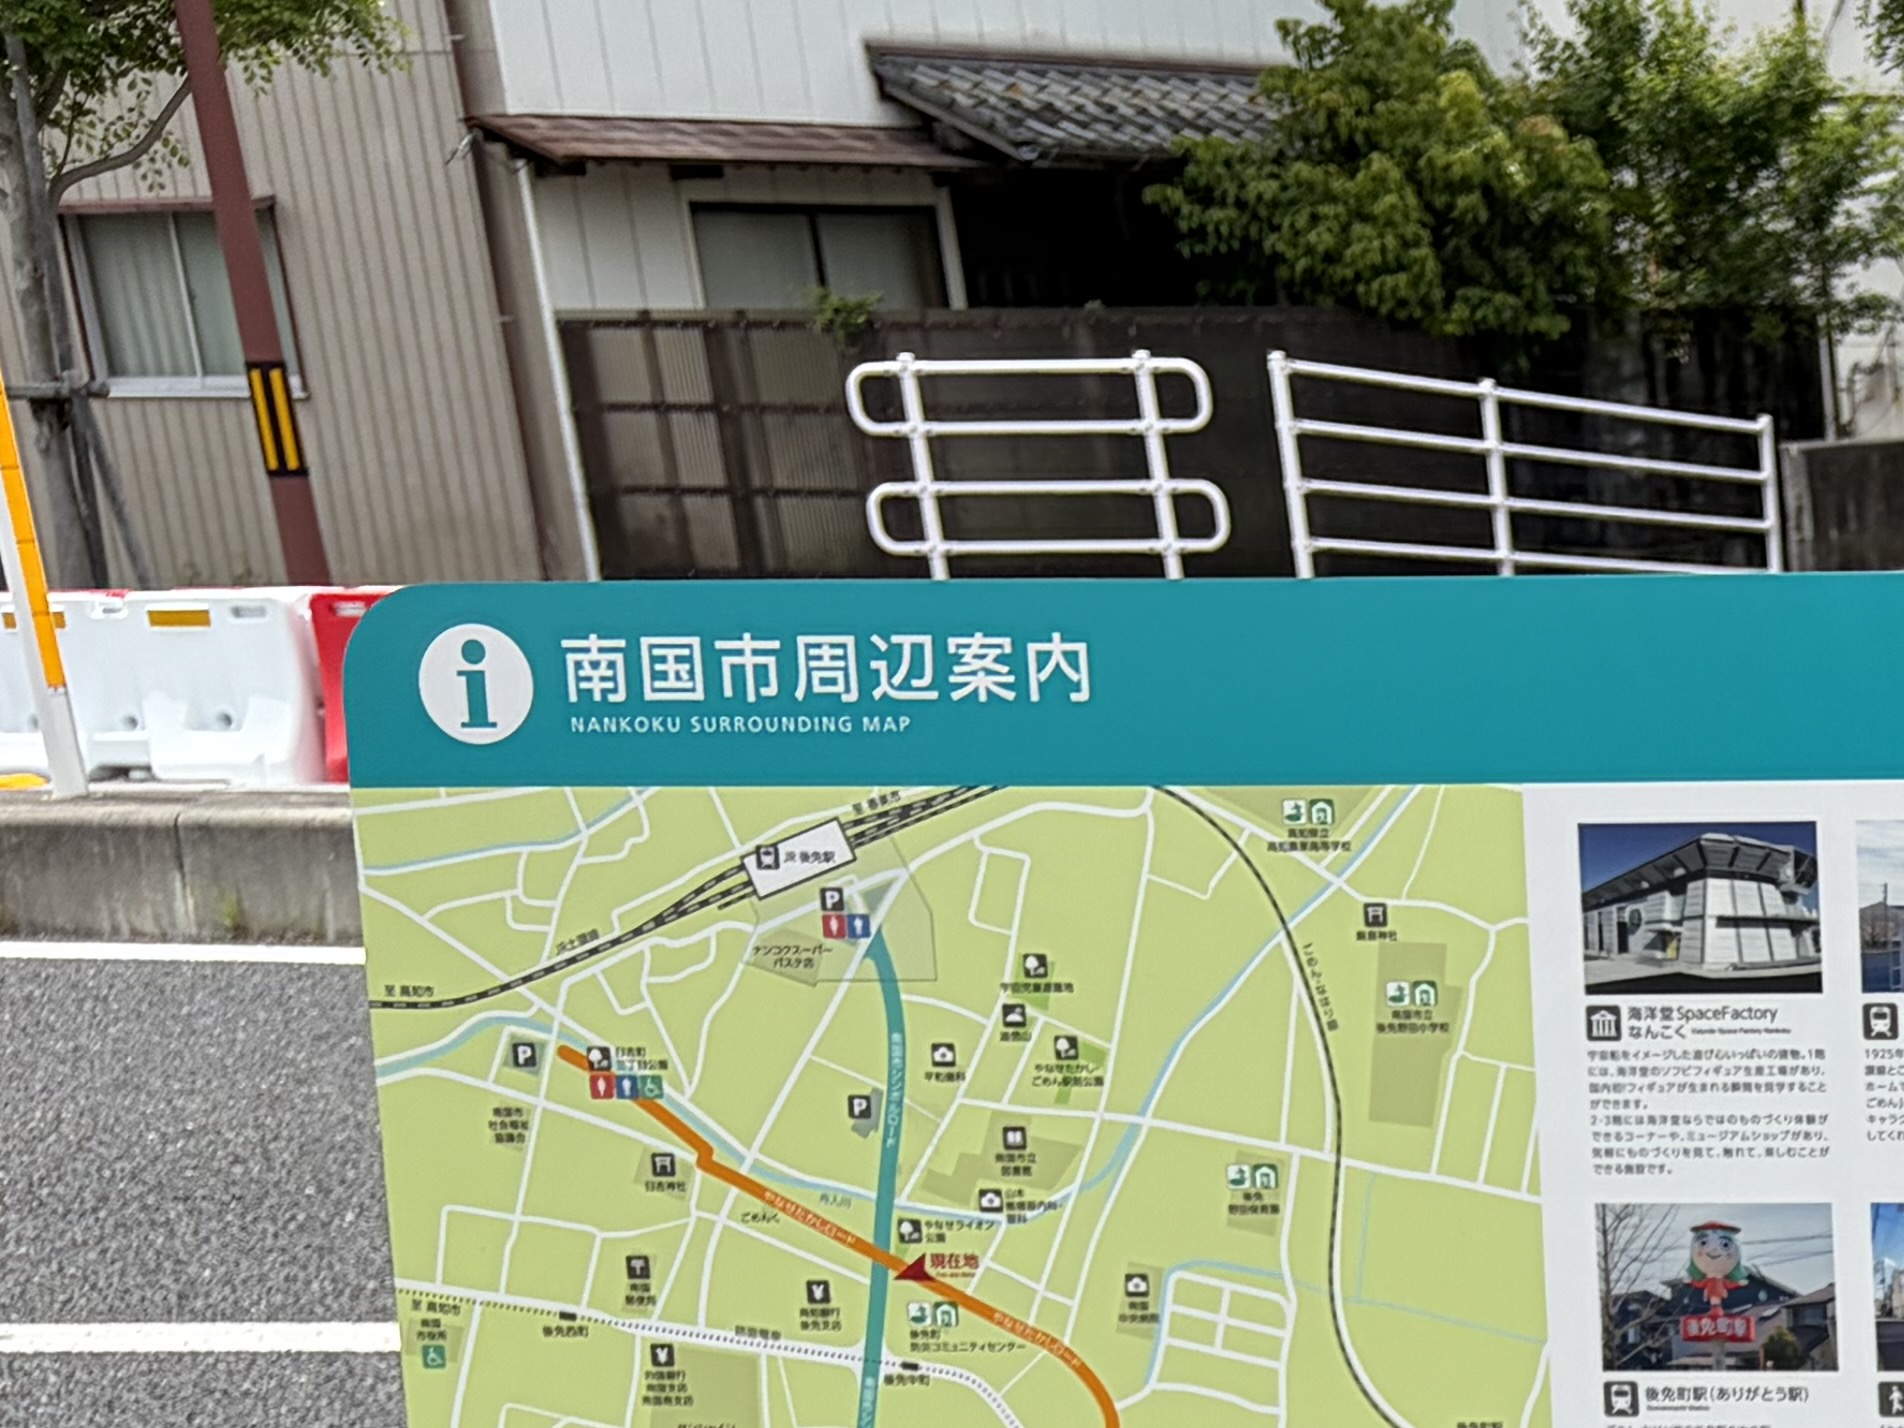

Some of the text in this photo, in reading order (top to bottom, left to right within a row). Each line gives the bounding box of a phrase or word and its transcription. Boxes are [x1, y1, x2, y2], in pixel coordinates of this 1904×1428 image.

[558, 632, 1092, 704] 南国市周辺案内
[571, 715, 911, 733] NANKOKU SURROUNDING MAP
[1629, 1025, 1687, 1039] なんこく
[930, 1253, 979, 1269] 現在地
[1646, 1385, 1810, 1402] 後免町駅(ありがとう駅)
